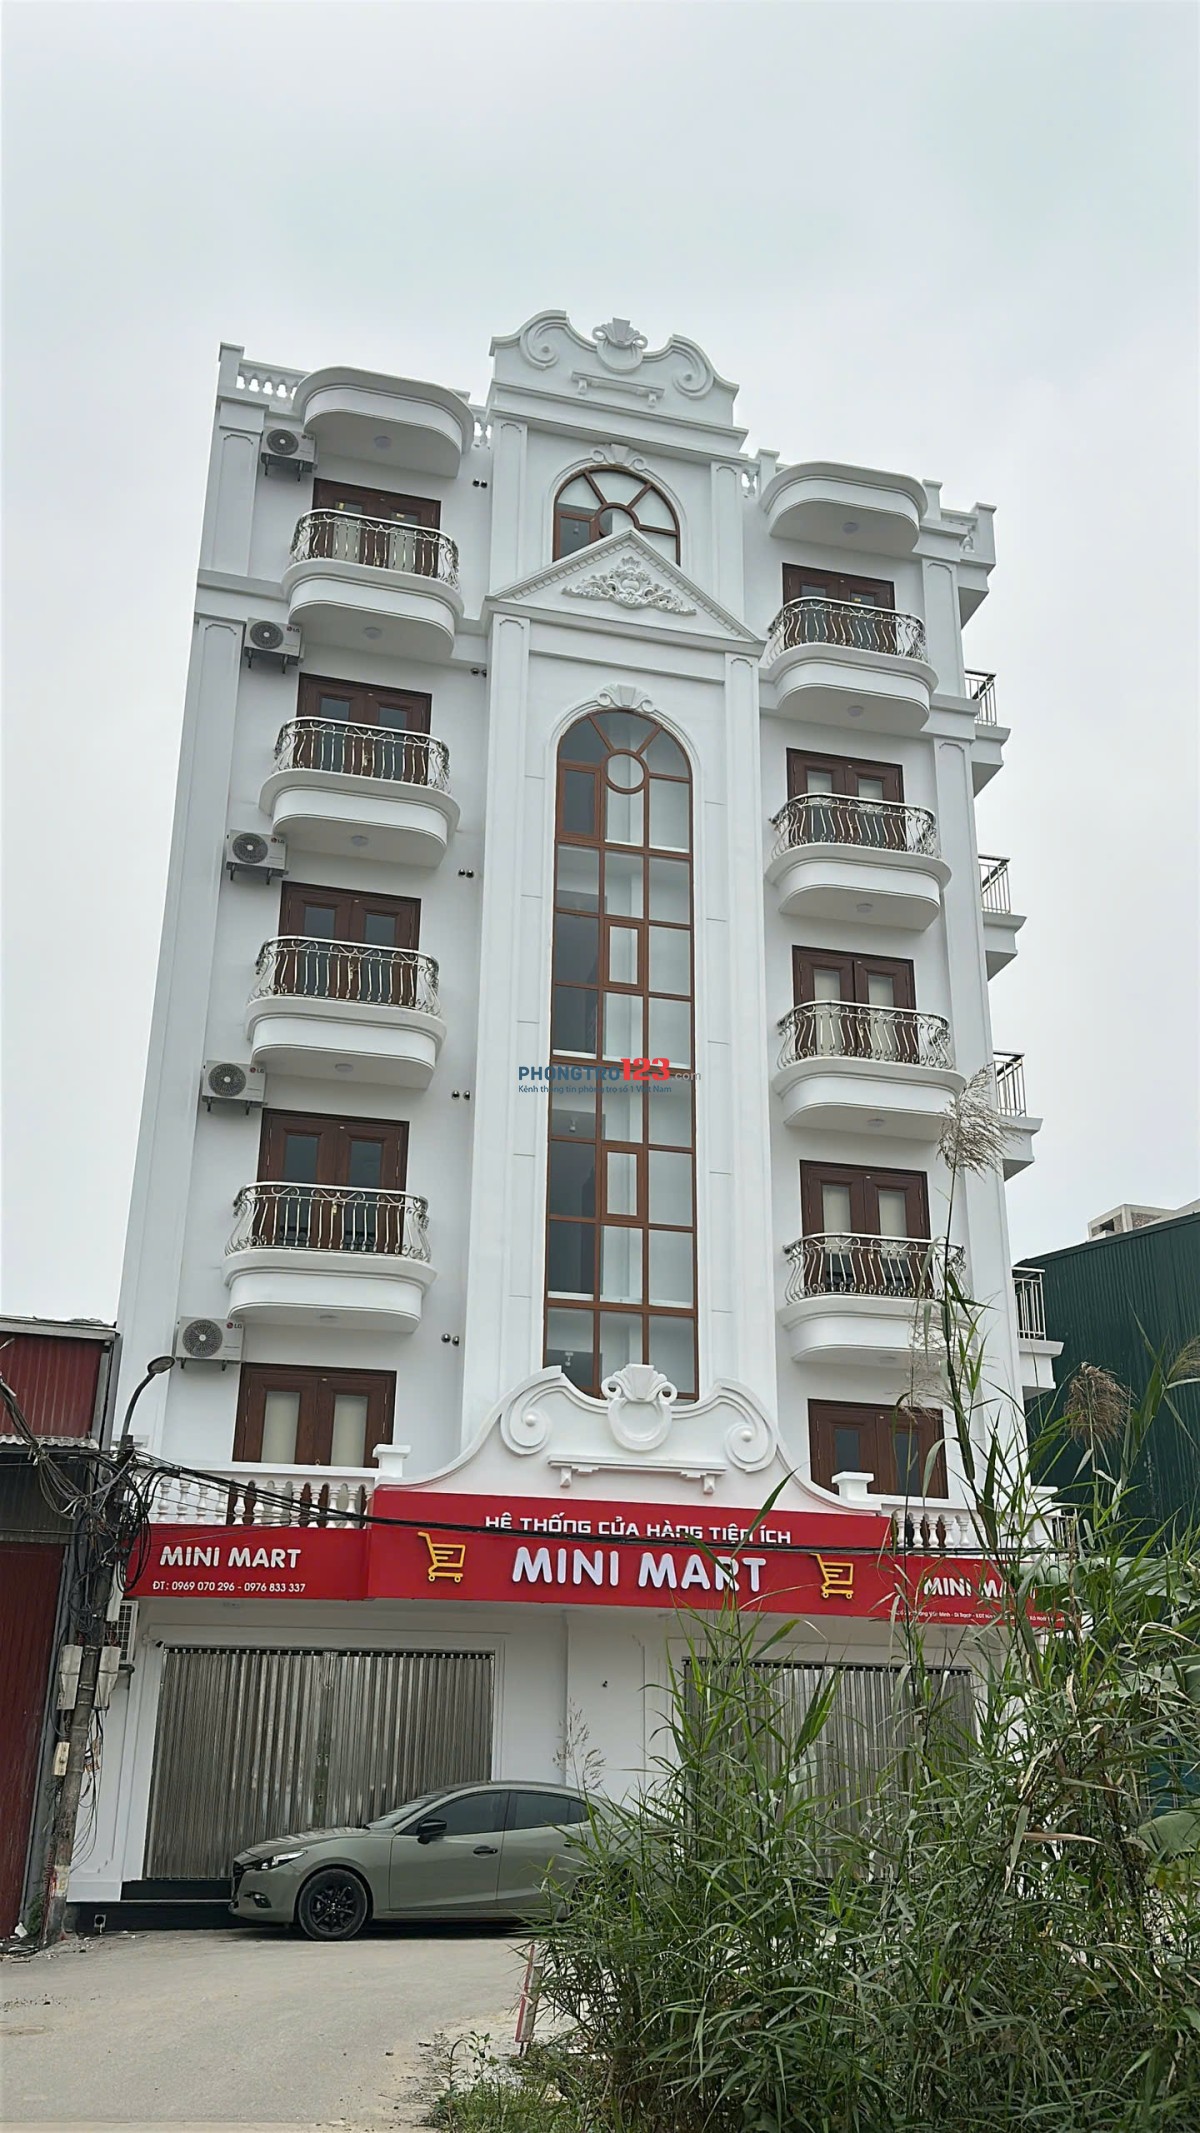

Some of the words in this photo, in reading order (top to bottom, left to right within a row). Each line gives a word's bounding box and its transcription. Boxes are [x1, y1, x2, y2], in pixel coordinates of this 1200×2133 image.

[519, 1511, 592, 1534] THỐNG
[598, 1515, 640, 1536] CỬA
[646, 1519, 703, 1539] HÀNG
[708, 1523, 754, 1544] TIỆN
[760, 1524, 791, 1544] ÍCH
[159, 1546, 220, 1568] MINI
[228, 1547, 301, 1569] MART
[512, 1546, 620, 1587] MINI
[638, 1551, 767, 1592] MART
[152, 1580, 170, 1590] ĐT:
[171, 1581, 195, 1591] 0969
[197, 1581, 216, 1591] 070
[217, 1581, 235, 1592] 296
[244, 1582, 267, 1592] 0976
[269, 1582, 286, 1593] 833
[288, 1583, 306, 1593] 337
[923, 1576, 972, 1597] MINI
